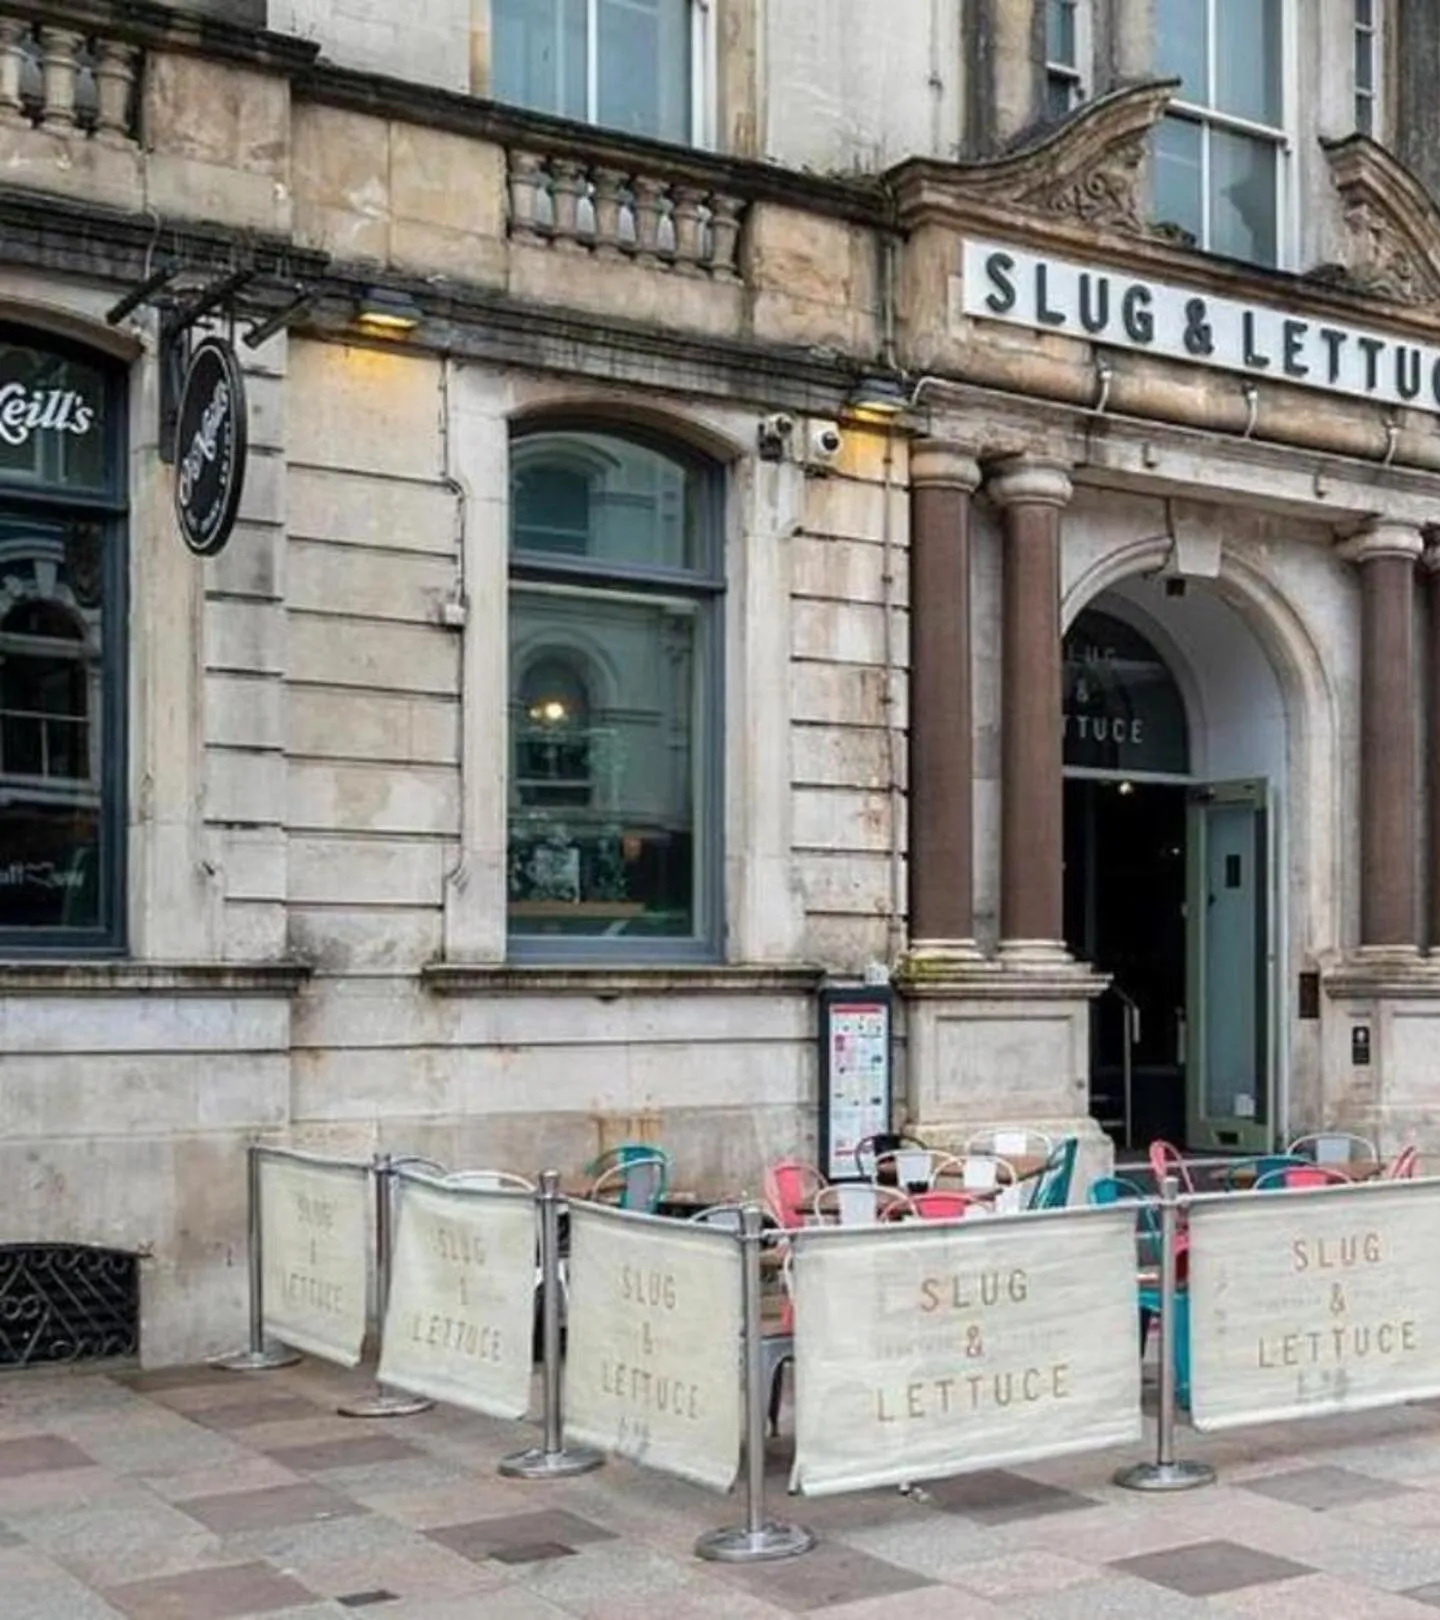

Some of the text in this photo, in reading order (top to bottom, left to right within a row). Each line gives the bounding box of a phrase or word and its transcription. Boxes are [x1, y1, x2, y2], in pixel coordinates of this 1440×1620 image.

[985, 251, 1154, 344] SLUG
[1184, 298, 1214, 356] &
[1293, 1232, 1383, 1273] SLUG
[622, 1263, 677, 1311] SLUG
[920, 1268, 1029, 1313] SLUG
[1330, 1282, 1346, 1317] &
[965, 1324, 984, 1359] &
[1258, 1320, 1418, 1369] LETTUCE
[602, 1360, 700, 1421] LETTUCE
[876, 1363, 1072, 1423] LETTUCE
